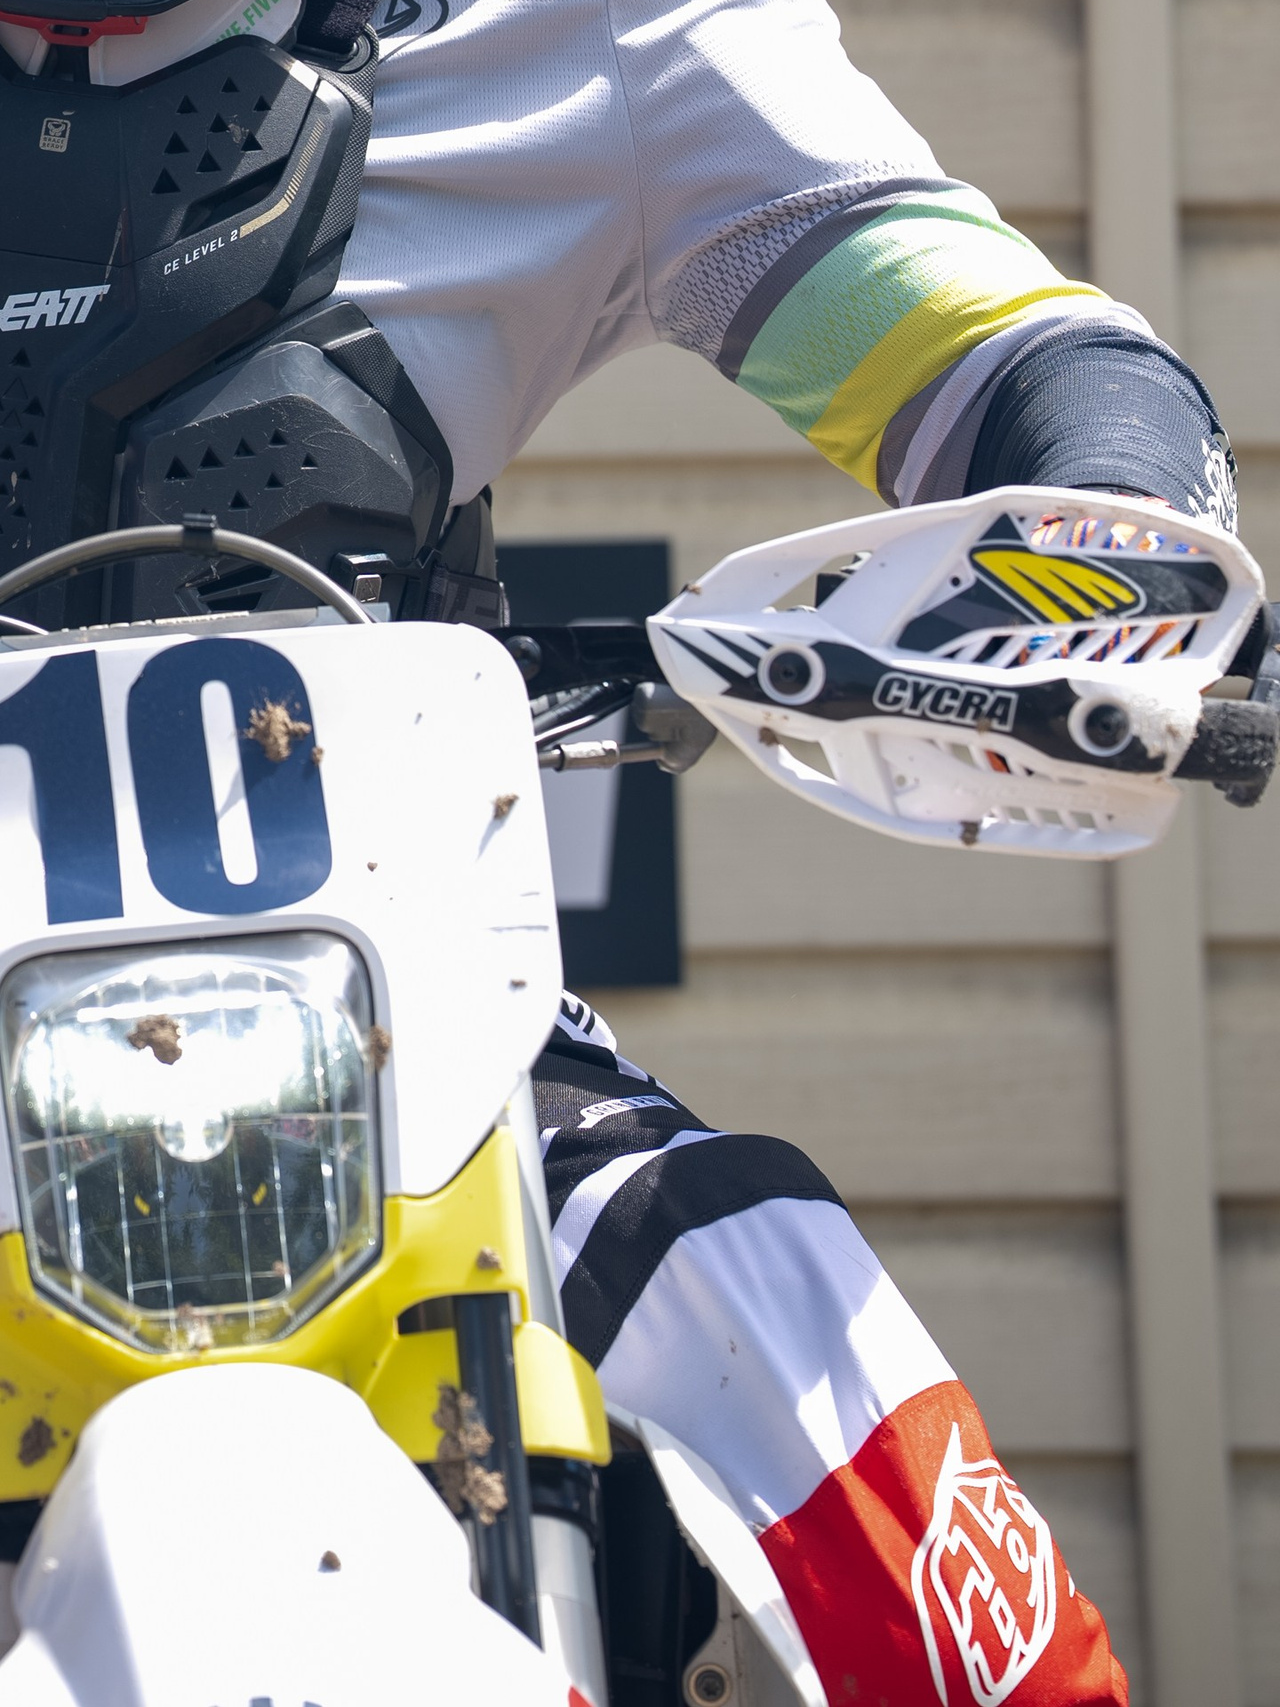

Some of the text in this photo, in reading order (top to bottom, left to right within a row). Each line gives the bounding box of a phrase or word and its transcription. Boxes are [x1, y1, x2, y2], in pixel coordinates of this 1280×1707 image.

[163, 229, 238, 275] CE LEVEL 2
[872, 671, 1019, 733] CYCRA
